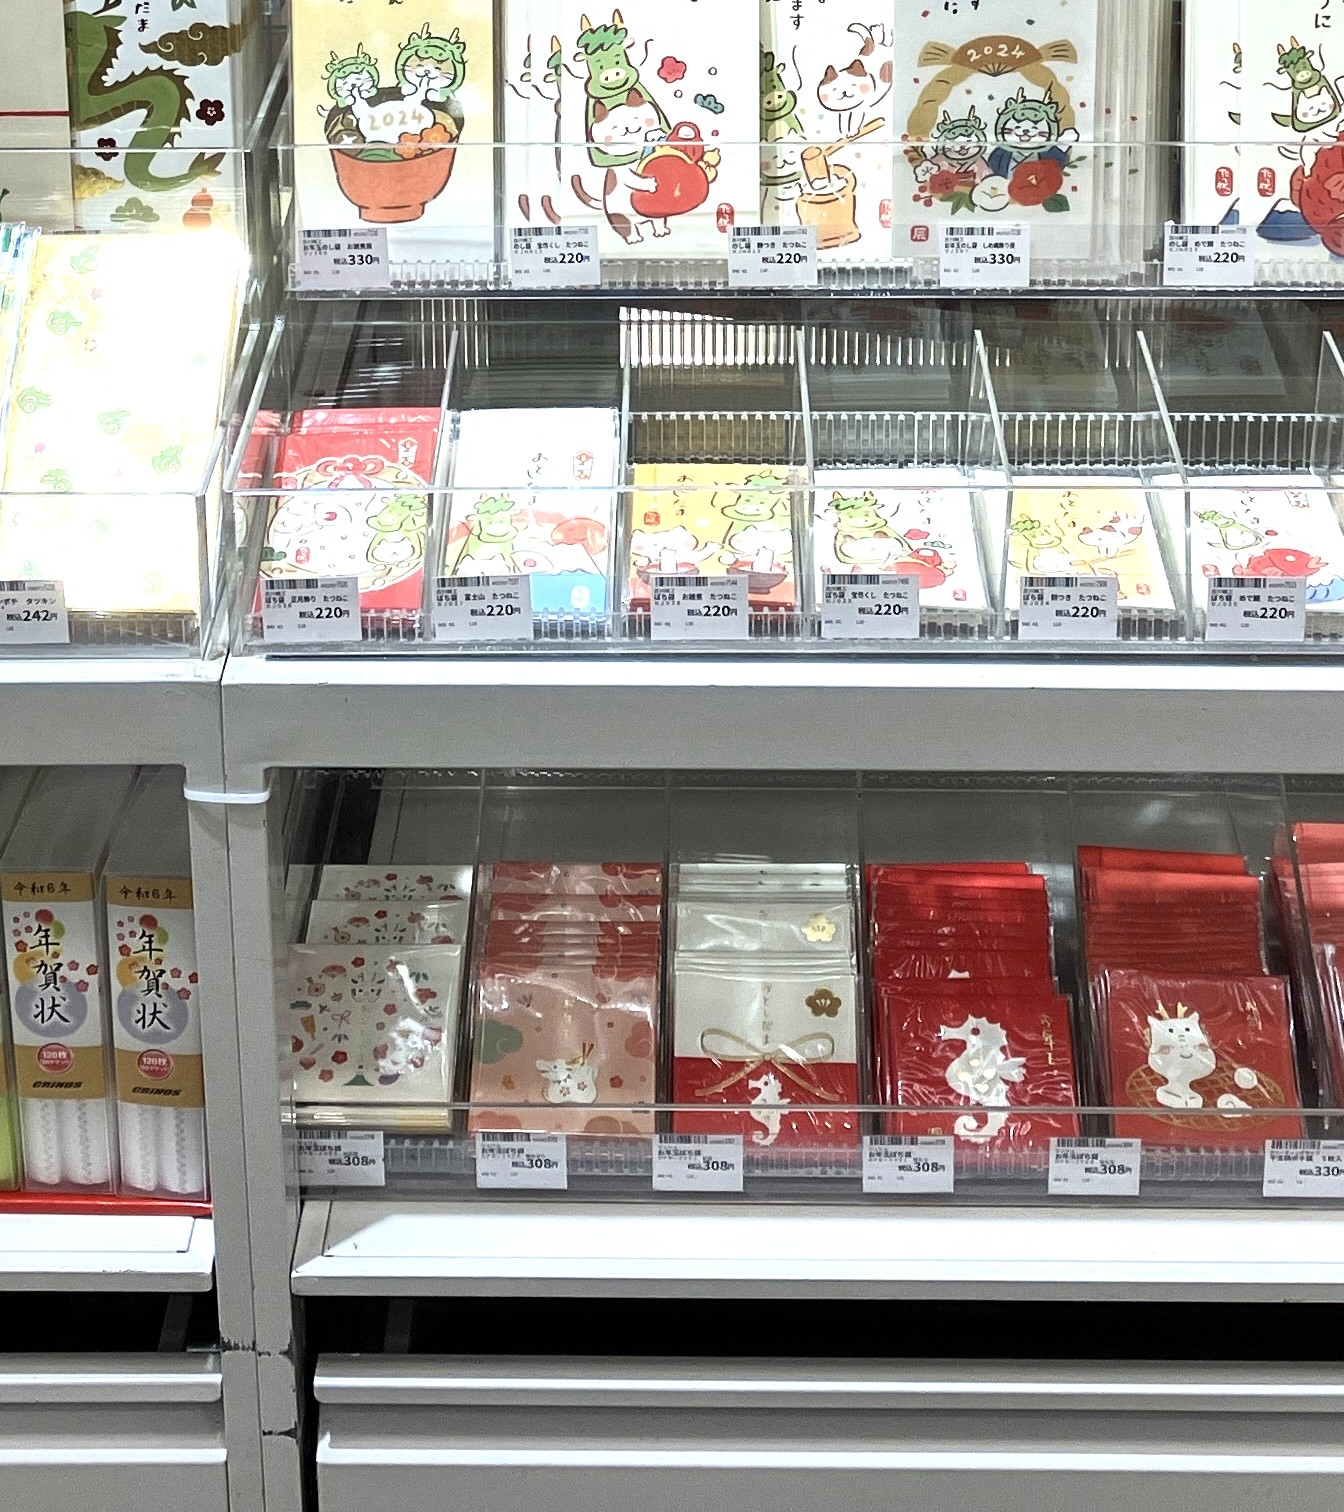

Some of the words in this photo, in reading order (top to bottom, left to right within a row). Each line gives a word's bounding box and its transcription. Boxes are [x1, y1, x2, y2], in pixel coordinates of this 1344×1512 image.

[964, 40, 1028, 63] 2024
[368, 107, 426, 131] 2024
[762, 253, 807, 264] 税込220円
[6, 610, 57, 622] 税込242円
[299, 607, 350, 618] 税込220円
[132, 928, 173, 1031] 年賀状
